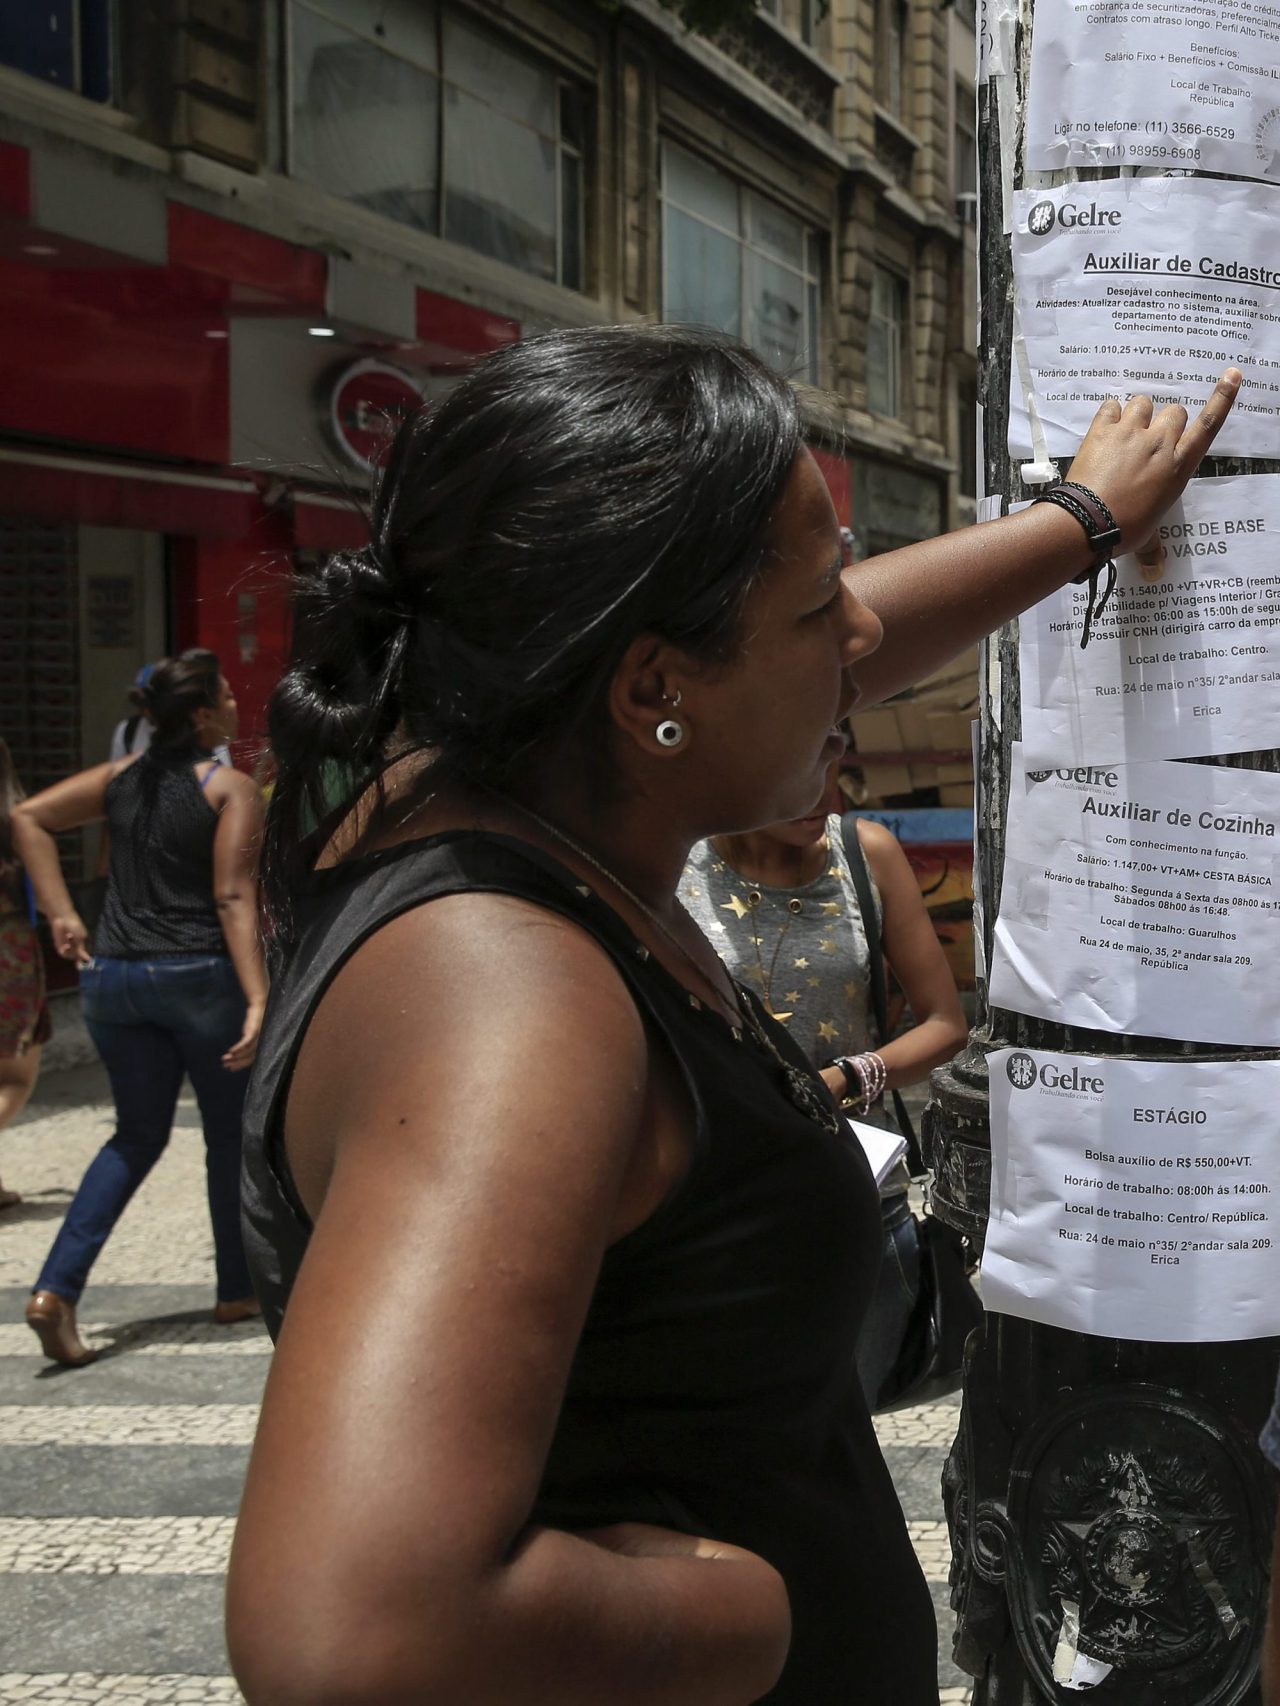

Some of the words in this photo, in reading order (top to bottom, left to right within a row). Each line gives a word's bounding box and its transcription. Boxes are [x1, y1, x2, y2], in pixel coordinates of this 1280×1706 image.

[1090, 1, 1129, 12] cobrança
[1147, 3, 1219, 18] securitizadoras,
[1086, 15, 1128, 24] Contratos
[1153, 16, 1182, 25] atraso
[1184, 18, 1213, 29] longo.
[1216, 21, 1238, 33] Perfil
[1240, 26, 1256, 37] Alto
[1104, 52, 1134, 61] Salário
[1137, 52, 1156, 61] Fixo
[1227, 61, 1269, 76] Comissão
[1170, 80, 1196, 90] Local
[1212, 83, 1253, 98] Trabalho:
[1189, 94, 1234, 107] República
[1095, 120, 1140, 131] telefone:
[1145, 121, 1168, 135] (11)
[1172, 122, 1235, 140] 3566-6529
[1129, 145, 1201, 160] 98959-6908
[1058, 202, 1121, 227] Gelre
[1084, 252, 1160, 271] Auxiliar
[1167, 255, 1191, 272] de
[1107, 287, 1152, 298] Desejável
[1155, 289, 1222, 302] conhecimento
[1225, 296, 1236, 304] na
[1239, 297, 1260, 308] área.
[1036, 299, 1080, 308] Atividades:
[1082, 299, 1120, 307] Atualizar
[1123, 299, 1165, 309] cadastro
[1225, 308, 1258, 318] auxiliar
[1111, 310, 1177, 321] departamento
[1194, 315, 1253, 330] atendimento.
[1114, 322, 1184, 333] Conhecimento
[1186, 326, 1218, 336] pacote
[1221, 329, 1250, 341] Office.
[1060, 345, 1090, 354] Salário:
[1094, 345, 1130, 355] 1.010,25
[1133, 346, 1171, 356] +VT+VR
[1189, 349, 1226, 361] R$20,00
[1237, 354, 1256, 364] Café
[1038, 369, 1066, 377] Horário
[1081, 369, 1120, 377] trabalho:
[1123, 369, 1165, 380] Segunda
[1176, 372, 1203, 382] Sexta
[1046, 392, 1067, 401] Local
[1152, 395, 1181, 405] Norte/
[1238, 402, 1273, 415] Próximo
[1199, 522, 1220, 536] DE
[1224, 519, 1265, 534] BASE
[1172, 541, 1227, 558] VAGAS
[1130, 583, 1174, 596] 1.540,00
[1177, 577, 1243, 591] +VT+VR+CB
[1172, 594, 1216, 607] Viagens
[1219, 591, 1256, 603] Interior
[1050, 621, 1083, 633] Horário
[1102, 614, 1150, 627] trabalho:
[1154, 610, 1184, 622] 06:00
[1204, 606, 1238, 617] 15:00h
[1241, 605, 1254, 614] de
[1089, 630, 1130, 641] Possuir
[1133, 626, 1158, 637] CNH
[1162, 621, 1205, 636] (dirigirá
[1208, 621, 1236, 631] carro
[1238, 618, 1251, 628] da
[1128, 654, 1160, 665] Local
[1162, 652, 1176, 662] de
[1179, 648, 1228, 661] trabalho:
[1231, 645, 1269, 656] Centro.
[1095, 685, 1120, 697] Rua:
[1123, 683, 1136, 694] 24
[1139, 682, 1153, 693] de
[1156, 680, 1184, 691] maio
[1261, 671, 1280, 682] sala
[1193, 705, 1221, 716] Erica
[1082, 797, 1161, 823] Auxiliar
[1166, 808, 1192, 827] de
[1198, 811, 1275, 837] Cozinha
[1105, 834, 1127, 845] Com
[1130, 839, 1198, 854] conhecimento
[1200, 847, 1212, 856] na
[1215, 848, 1248, 861] função.
[1077, 853, 1110, 867] Salário:
[1113, 860, 1158, 872] 1.147,00+
[1160, 865, 1200, 877] VT+AM+
[1203, 870, 1235, 882] CESTA
[1237, 873, 1272, 886] BÁSICA
[1044, 870, 1073, 884] Horário
[1087, 879, 1128, 893] trabalho:
[1131, 885, 1173, 898] Segunda
[1184, 892, 1210, 903] Sexta
[1213, 895, 1229, 905] das
[1232, 897, 1259, 908] 08h00
[1113, 894, 1155, 908] Sábados
[1158, 900, 1187, 911] 08h00
[1203, 906, 1230, 917] 16:48.
[1100, 915, 1125, 928] Local
[1128, 920, 1140, 929] de
[1142, 922, 1185, 935] trabalho:
[1188, 928, 1237, 941] Guarulhos
[1080, 935, 1097, 947] Rua
[1099, 939, 1110, 949] 24
[1112, 941, 1124, 951] de
[1126, 944, 1152, 956] maio,
[1184, 951, 1211, 962] andar
[1213, 954, 1232, 964] sala
[1235, 956, 1253, 966] 209.
[1141, 957, 1189, 971] República
[1039, 1064, 1105, 1093] Gelre
[1133, 1107, 1207, 1124] ESTÁGIO
[1085, 1149, 1115, 1163] Bolsa
[1118, 1154, 1156, 1167] auxílio
[1159, 1157, 1173, 1167] de
[1176, 1158, 1191, 1169] R$
[1195, 1156, 1252, 1168] 550,00+VT.
[1064, 1174, 1103, 1189] Horário
[1106, 1180, 1120, 1191] de
[1123, 1183, 1174, 1195] trabalho:
[1177, 1185, 1214, 1196] 08:00h
[1233, 1184, 1271, 1194] 14:00h.
[1065, 1202, 1094, 1215] Local
[1096, 1207, 1110, 1217] de
[1113, 1209, 1164, 1222] trabalho:
[1167, 1213, 1209, 1224] Centro/
[1212, 1211, 1269, 1224] República.
[1059, 1228, 1083, 1241] Rua:
[1086, 1232, 1098, 1243] 24
[1101, 1235, 1115, 1246] de
[1118, 1238, 1145, 1249] maio
[1227, 1239, 1249, 1250] sala
[1252, 1238, 1273, 1249] 209.
[1151, 1254, 1180, 1265] Erica
